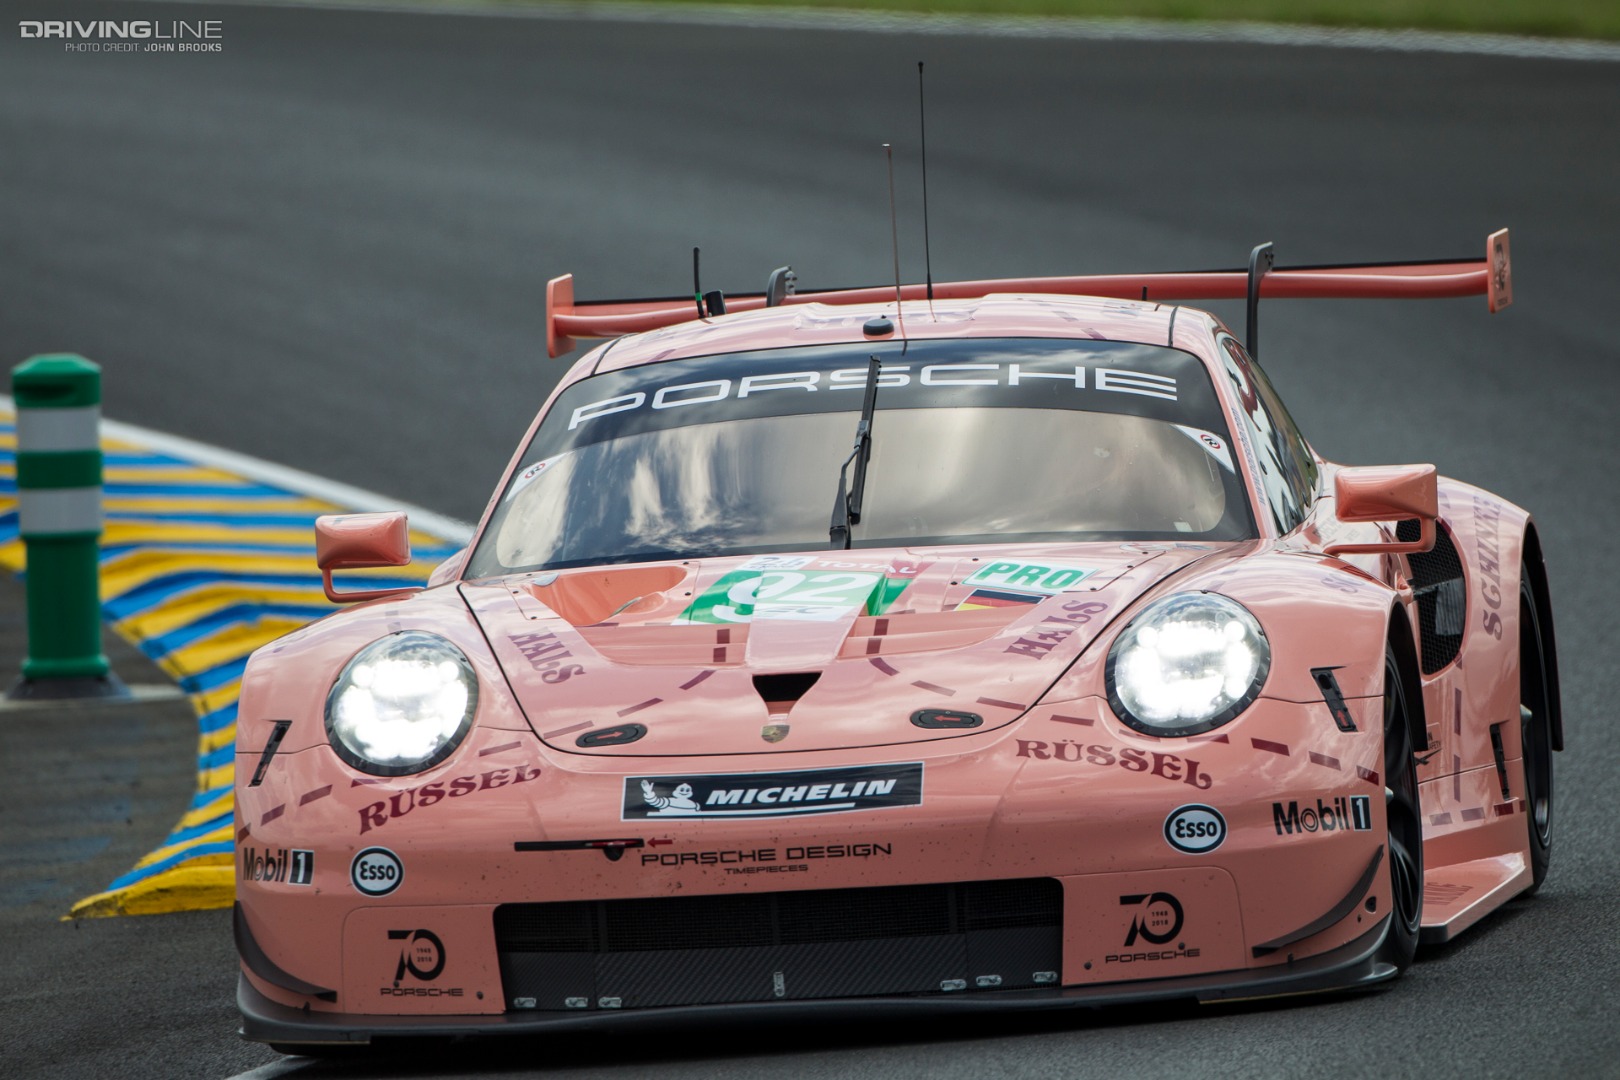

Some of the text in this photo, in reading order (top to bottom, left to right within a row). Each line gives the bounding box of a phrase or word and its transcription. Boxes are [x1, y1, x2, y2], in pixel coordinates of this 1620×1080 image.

[567, 363, 1178, 430] PORSCHE
[817, 560, 918, 574] TOTAL
[975, 562, 1084, 589] PRO
[712, 571, 880, 623] 92
[1015, 738, 1213, 790] RÜSSEL
[358, 763, 542, 836] RÜSSEL
[705, 778, 897, 806] MICHELIN
[1174, 817, 1218, 839] Esso
[1272, 796, 1350, 836] Mobil
[243, 847, 288, 883] Mobil
[641, 843, 892, 867] PORSCHE DESIGN
[359, 860, 396, 882] Esso
[724, 864, 809, 876] TIMEPIECES
[1119, 891, 1185, 947] 70
[1151, 910, 1169, 918] 1948
[1105, 948, 1201, 964] PORSCHE
[380, 987, 464, 997] PORSCHE
